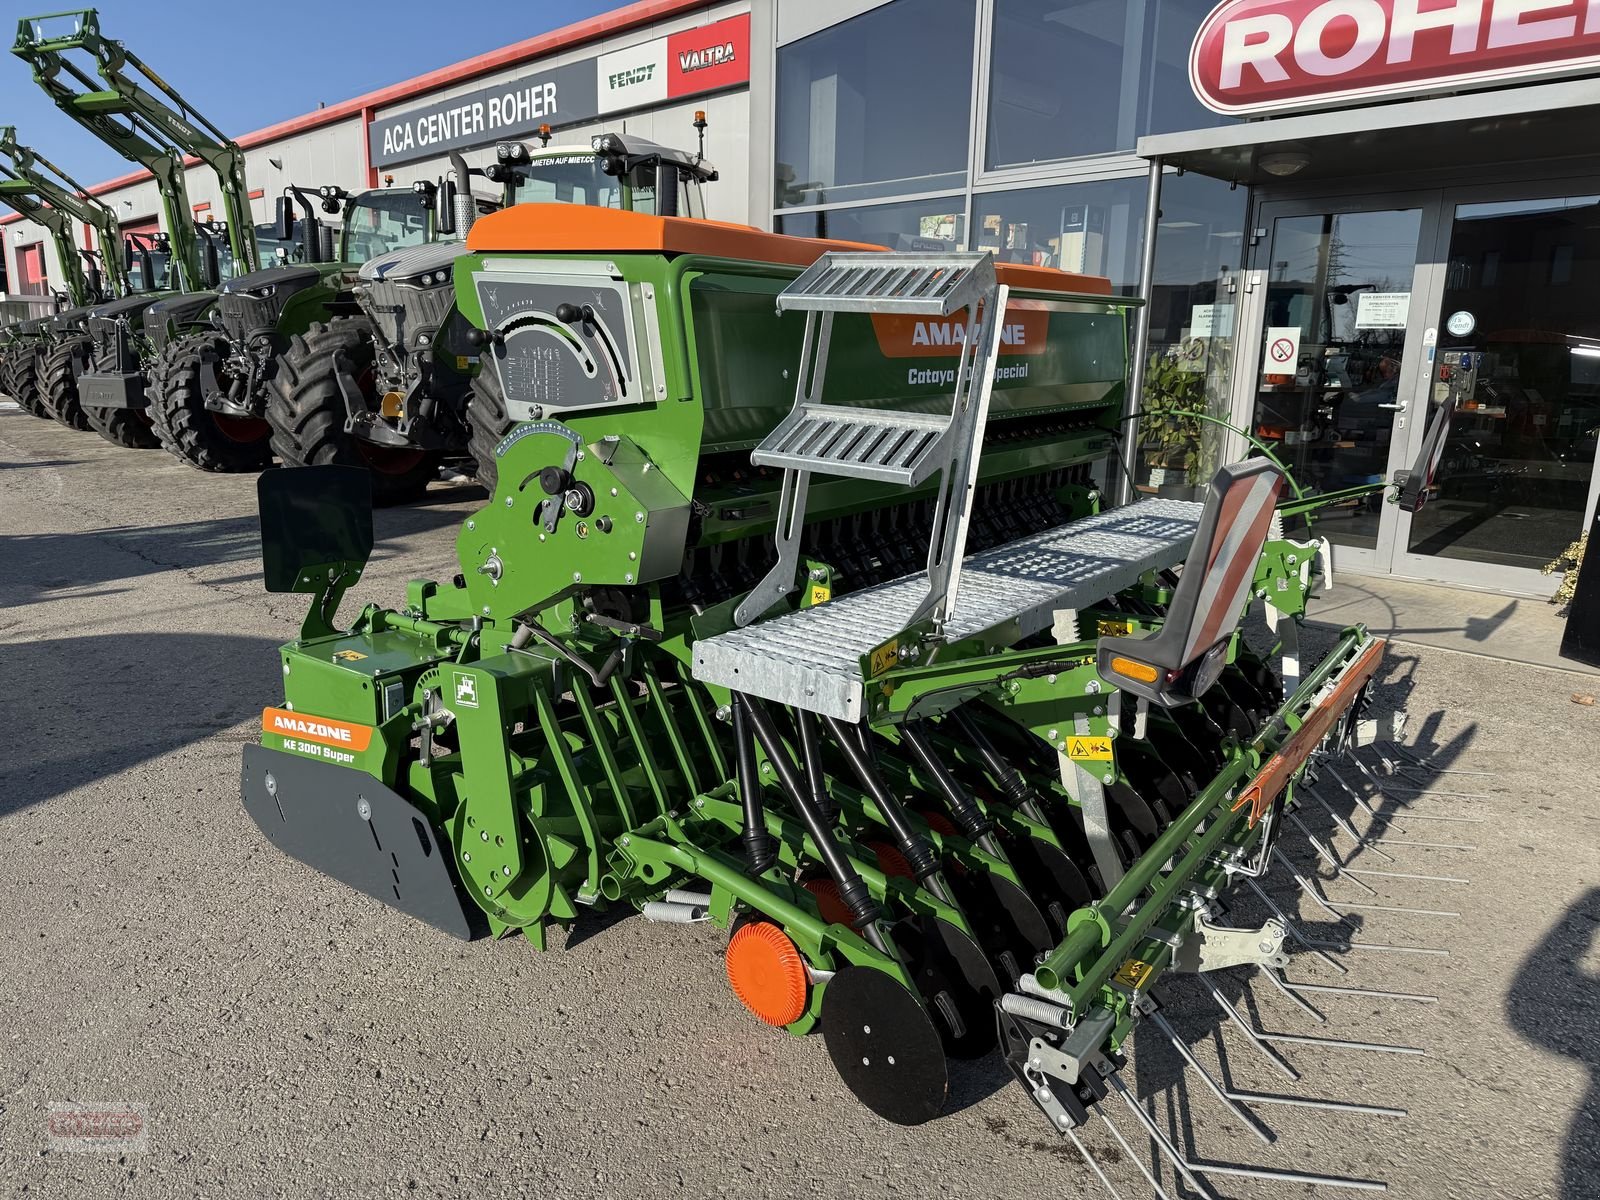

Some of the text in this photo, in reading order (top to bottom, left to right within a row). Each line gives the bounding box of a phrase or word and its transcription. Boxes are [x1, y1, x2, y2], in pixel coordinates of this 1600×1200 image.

[678, 42, 735, 73] VALTRA
[609, 63, 656, 89] FENDT
[168, 115, 192, 136] FENDT
[383, 82, 557, 155] ACA CENTER ROHER
[532, 158, 555, 167] MIETEN
[555, 157, 568, 165] AUF
[908, 368, 954, 386] Cataya
[274, 715, 352, 742] AMAZONE
[283, 739, 355, 764] KE 3001 Super
